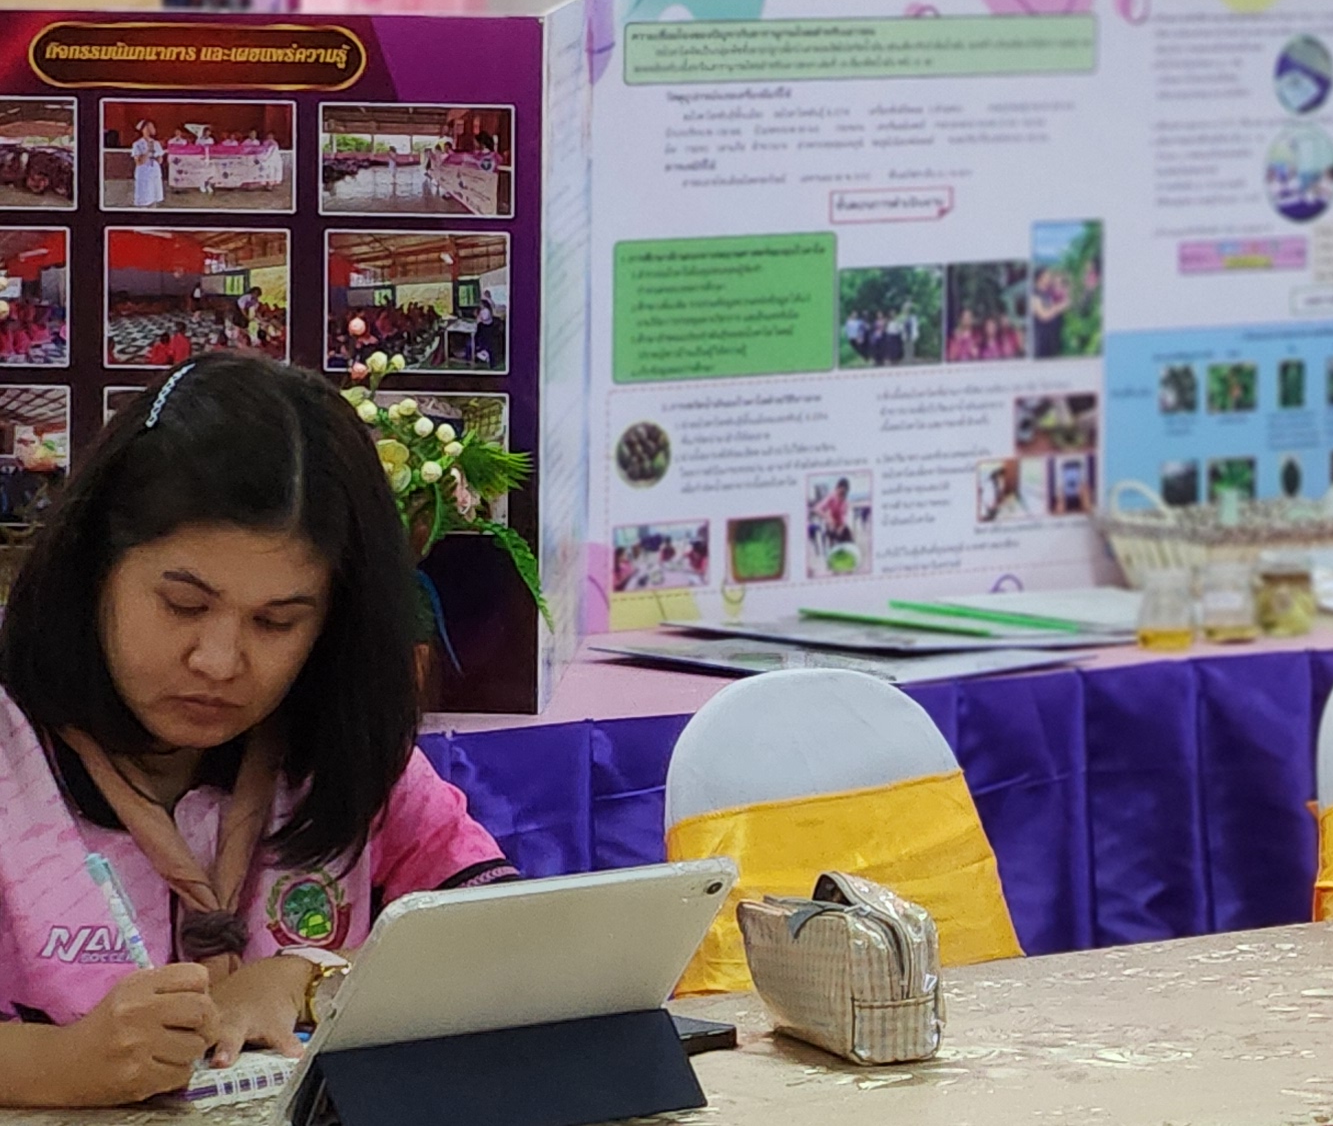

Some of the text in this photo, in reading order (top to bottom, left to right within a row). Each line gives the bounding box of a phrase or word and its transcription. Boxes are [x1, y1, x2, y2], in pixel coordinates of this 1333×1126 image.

[200, 43, 349, 70] และเผยแพร่ความรู้
